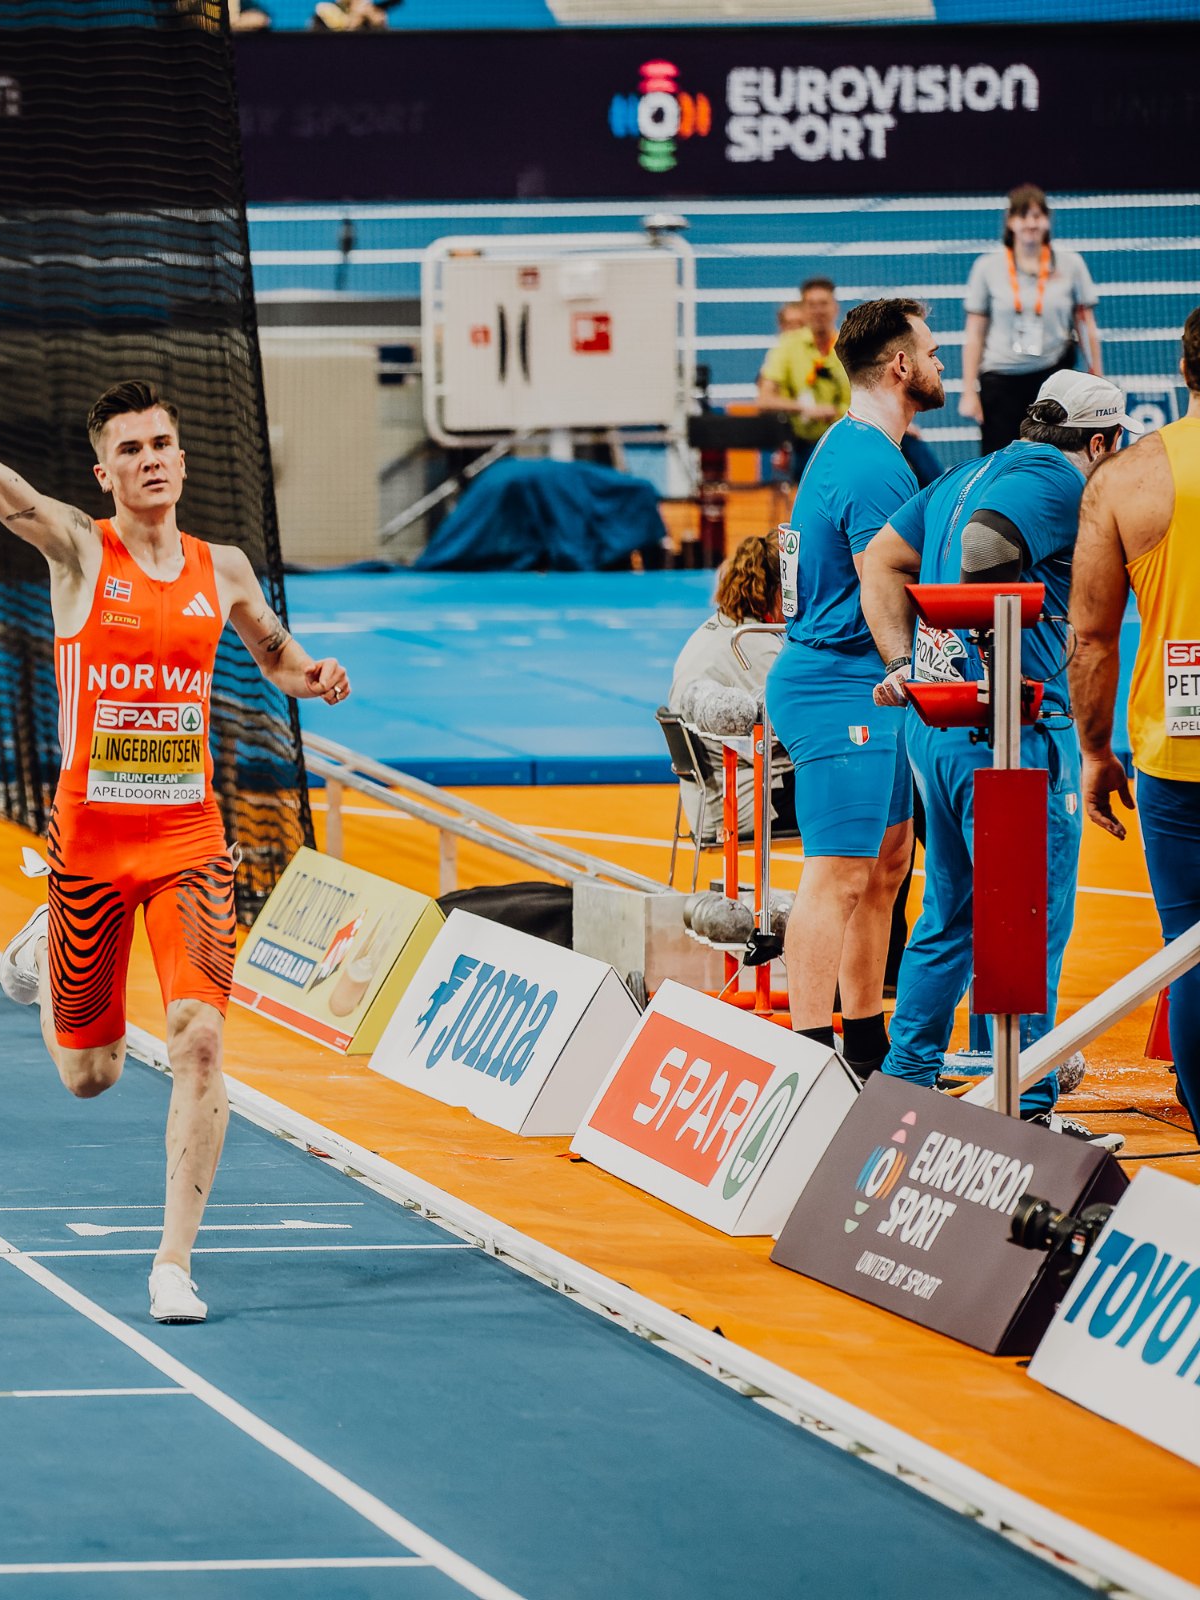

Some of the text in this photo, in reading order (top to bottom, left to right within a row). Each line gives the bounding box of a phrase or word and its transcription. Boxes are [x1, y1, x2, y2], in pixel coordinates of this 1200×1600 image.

[726, 63, 1039, 114] EUROVISION
[726, 112, 897, 162] SPORT
[1095, 407, 1118, 417] ITALIA
[114, 615, 137, 625] EXTRA
[98, 707, 178, 729] SPAR
[92, 736, 201, 763] J. INGEBRIGTSEN
[93, 786, 201, 800] APELDOORN 2025
[119, 772, 141, 783] RUN
[142, 773, 178, 784] CLEAN
[251, 941, 314, 984] SWITZERLAND
[632, 1046, 759, 1162] SPAR
[908, 1131, 1034, 1216] EUROVISION
[876, 1186, 957, 1251] SPORT
[855, 1250, 943, 1300] UNITED BY SPORT
[1064, 1229, 1200, 1386] TOYO
